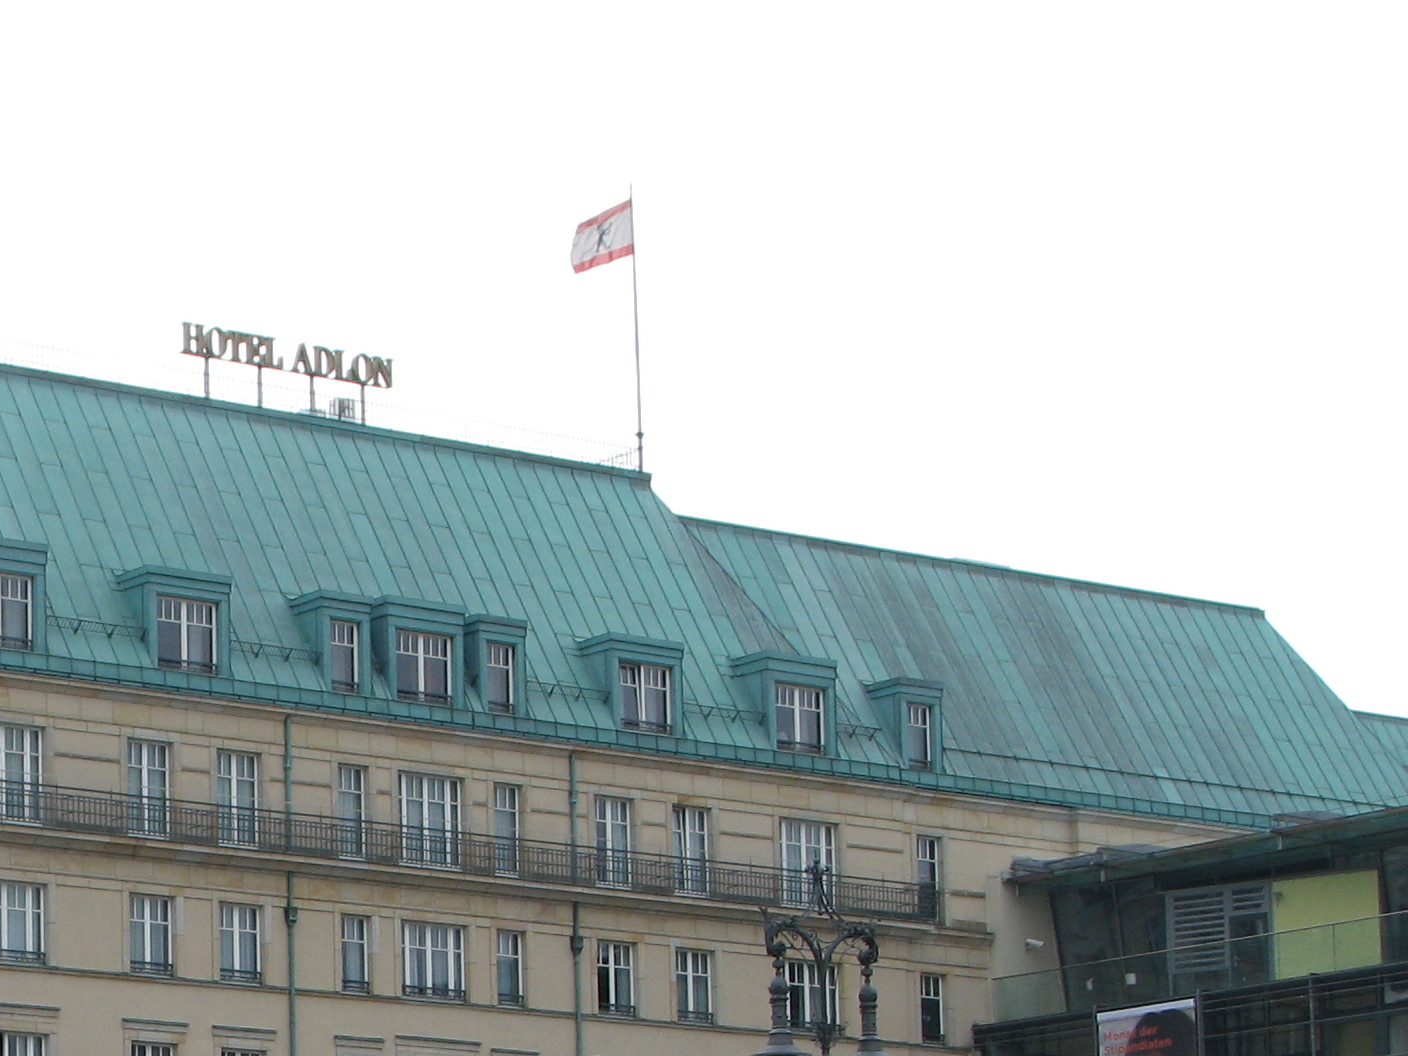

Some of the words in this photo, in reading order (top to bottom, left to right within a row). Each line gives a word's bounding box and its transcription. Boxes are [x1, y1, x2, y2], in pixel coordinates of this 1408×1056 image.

[180, 321, 283, 370] HOTEL
[291, 343, 393, 389] ADLON
[1140, 1026, 1158, 1037] der
